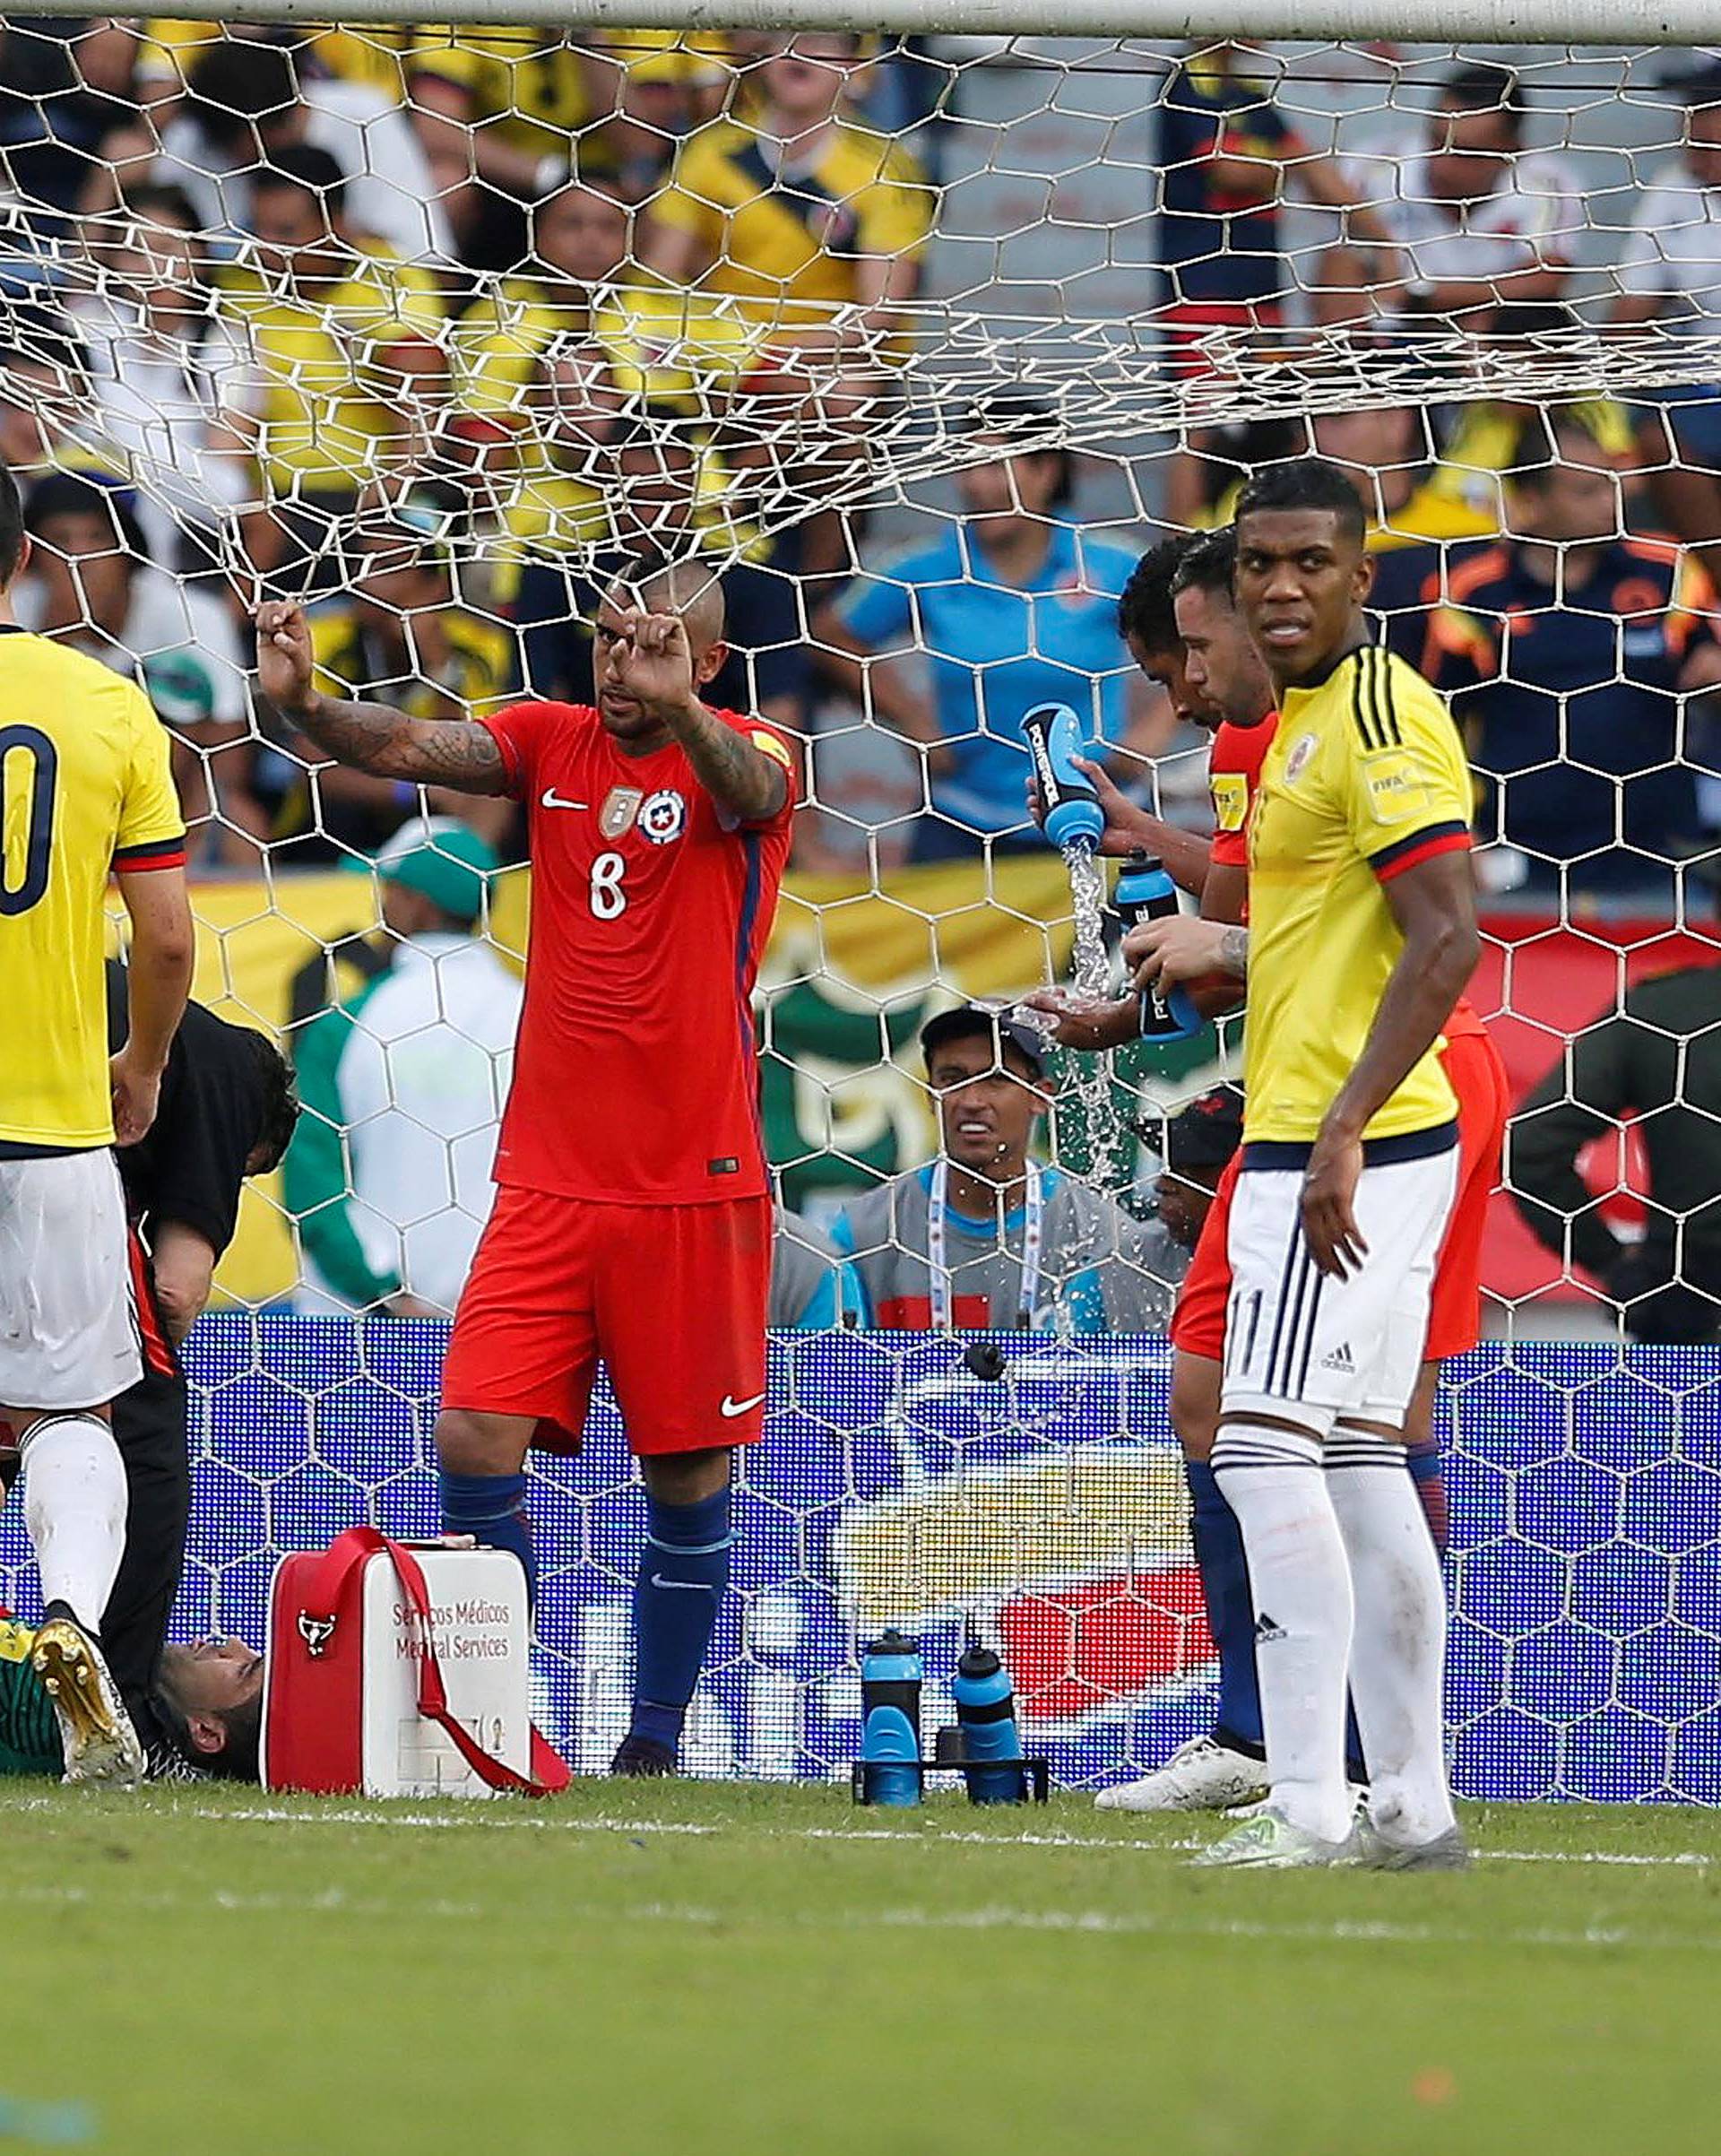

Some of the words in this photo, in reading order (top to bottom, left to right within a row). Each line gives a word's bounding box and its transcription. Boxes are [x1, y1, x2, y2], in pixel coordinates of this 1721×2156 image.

[1372, 775, 1405, 793] FIFA
[591, 852, 627, 920] 8
[1225, 1289, 1263, 1378] 11
[393, 1603, 453, 1631] Serços
[455, 1599, 510, 1626] Médicos
[453, 1633, 509, 1659] Services
